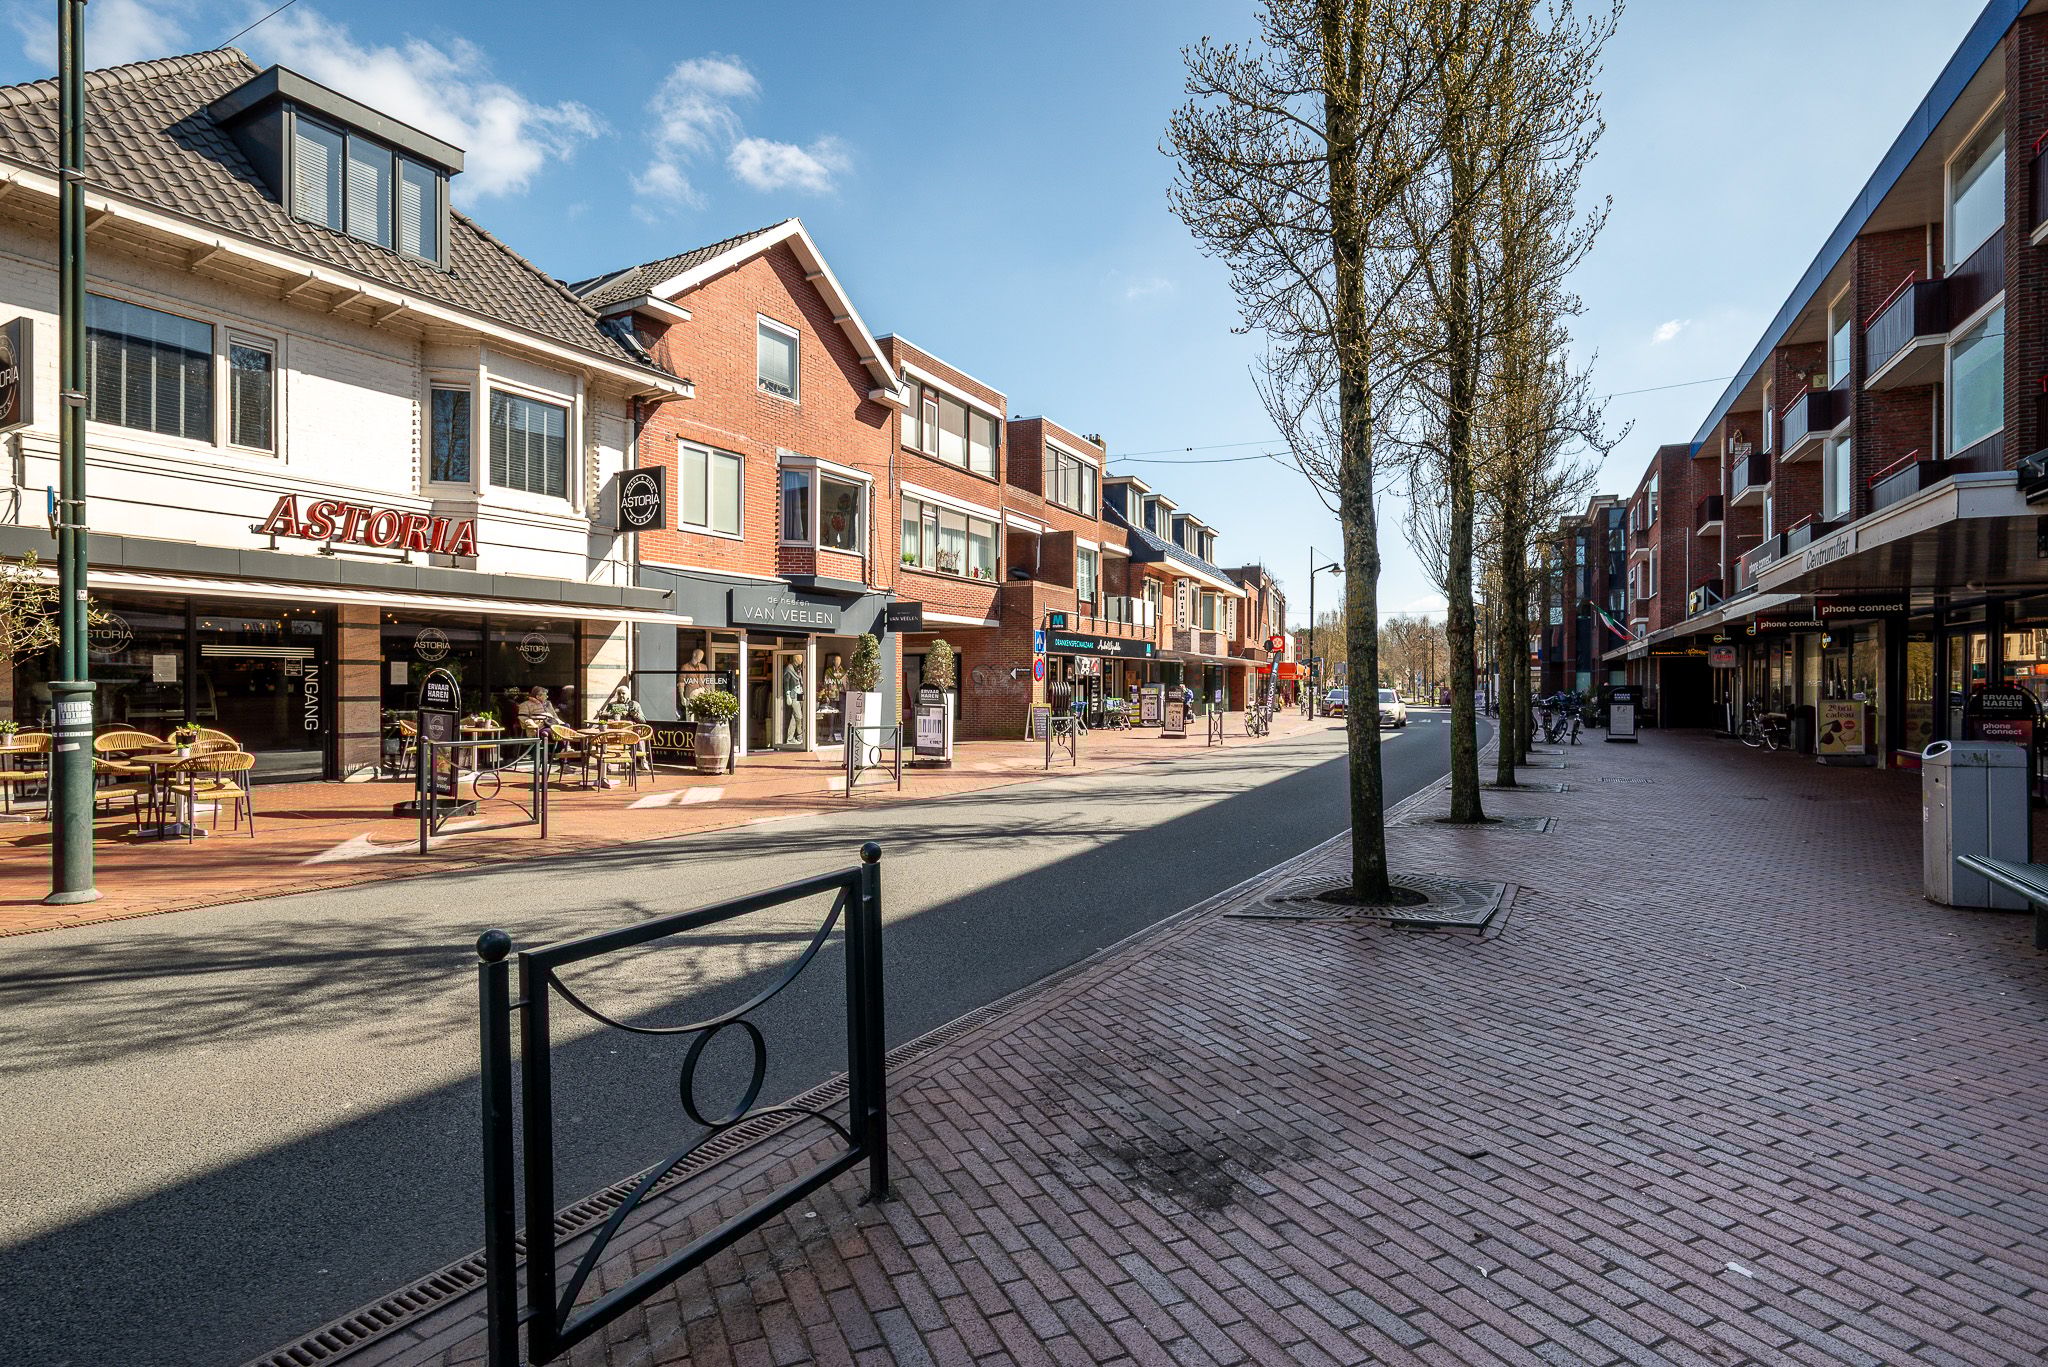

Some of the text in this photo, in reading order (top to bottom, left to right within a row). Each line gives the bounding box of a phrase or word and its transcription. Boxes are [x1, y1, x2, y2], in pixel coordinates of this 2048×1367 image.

[0, 366, 19, 388] ORIA
[621, 494, 660, 509] ASTORIA
[261, 493, 478, 558] ASTORIA
[1806, 537, 1848, 570] Centrumflat
[1748, 552, 1772, 579] phone connect
[767, 595, 811, 608] de heeren
[1178, 581, 1187, 630] Konings
[743, 605, 834, 625] VAN VEELEN
[1822, 603, 1904, 616] phone connect
[1760, 620, 1824, 630] phone connect
[88, 629, 134, 640] STORIA
[413, 641, 451, 651] ASTORIA
[519, 645, 550, 655] ASTORIA
[427, 682, 450, 692] ERVAAR
[683, 677, 729, 685] VAN VEELEN
[303, 664, 320, 731] INGANG
[427, 691, 449, 700] HAREN
[1838, 704, 1852, 712] bril
[1825, 711, 1854, 719] cadeau
[1983, 722, 2011, 731] phone
[650, 730, 695, 748] ASTOR
[854, 740, 862, 767] VAN
